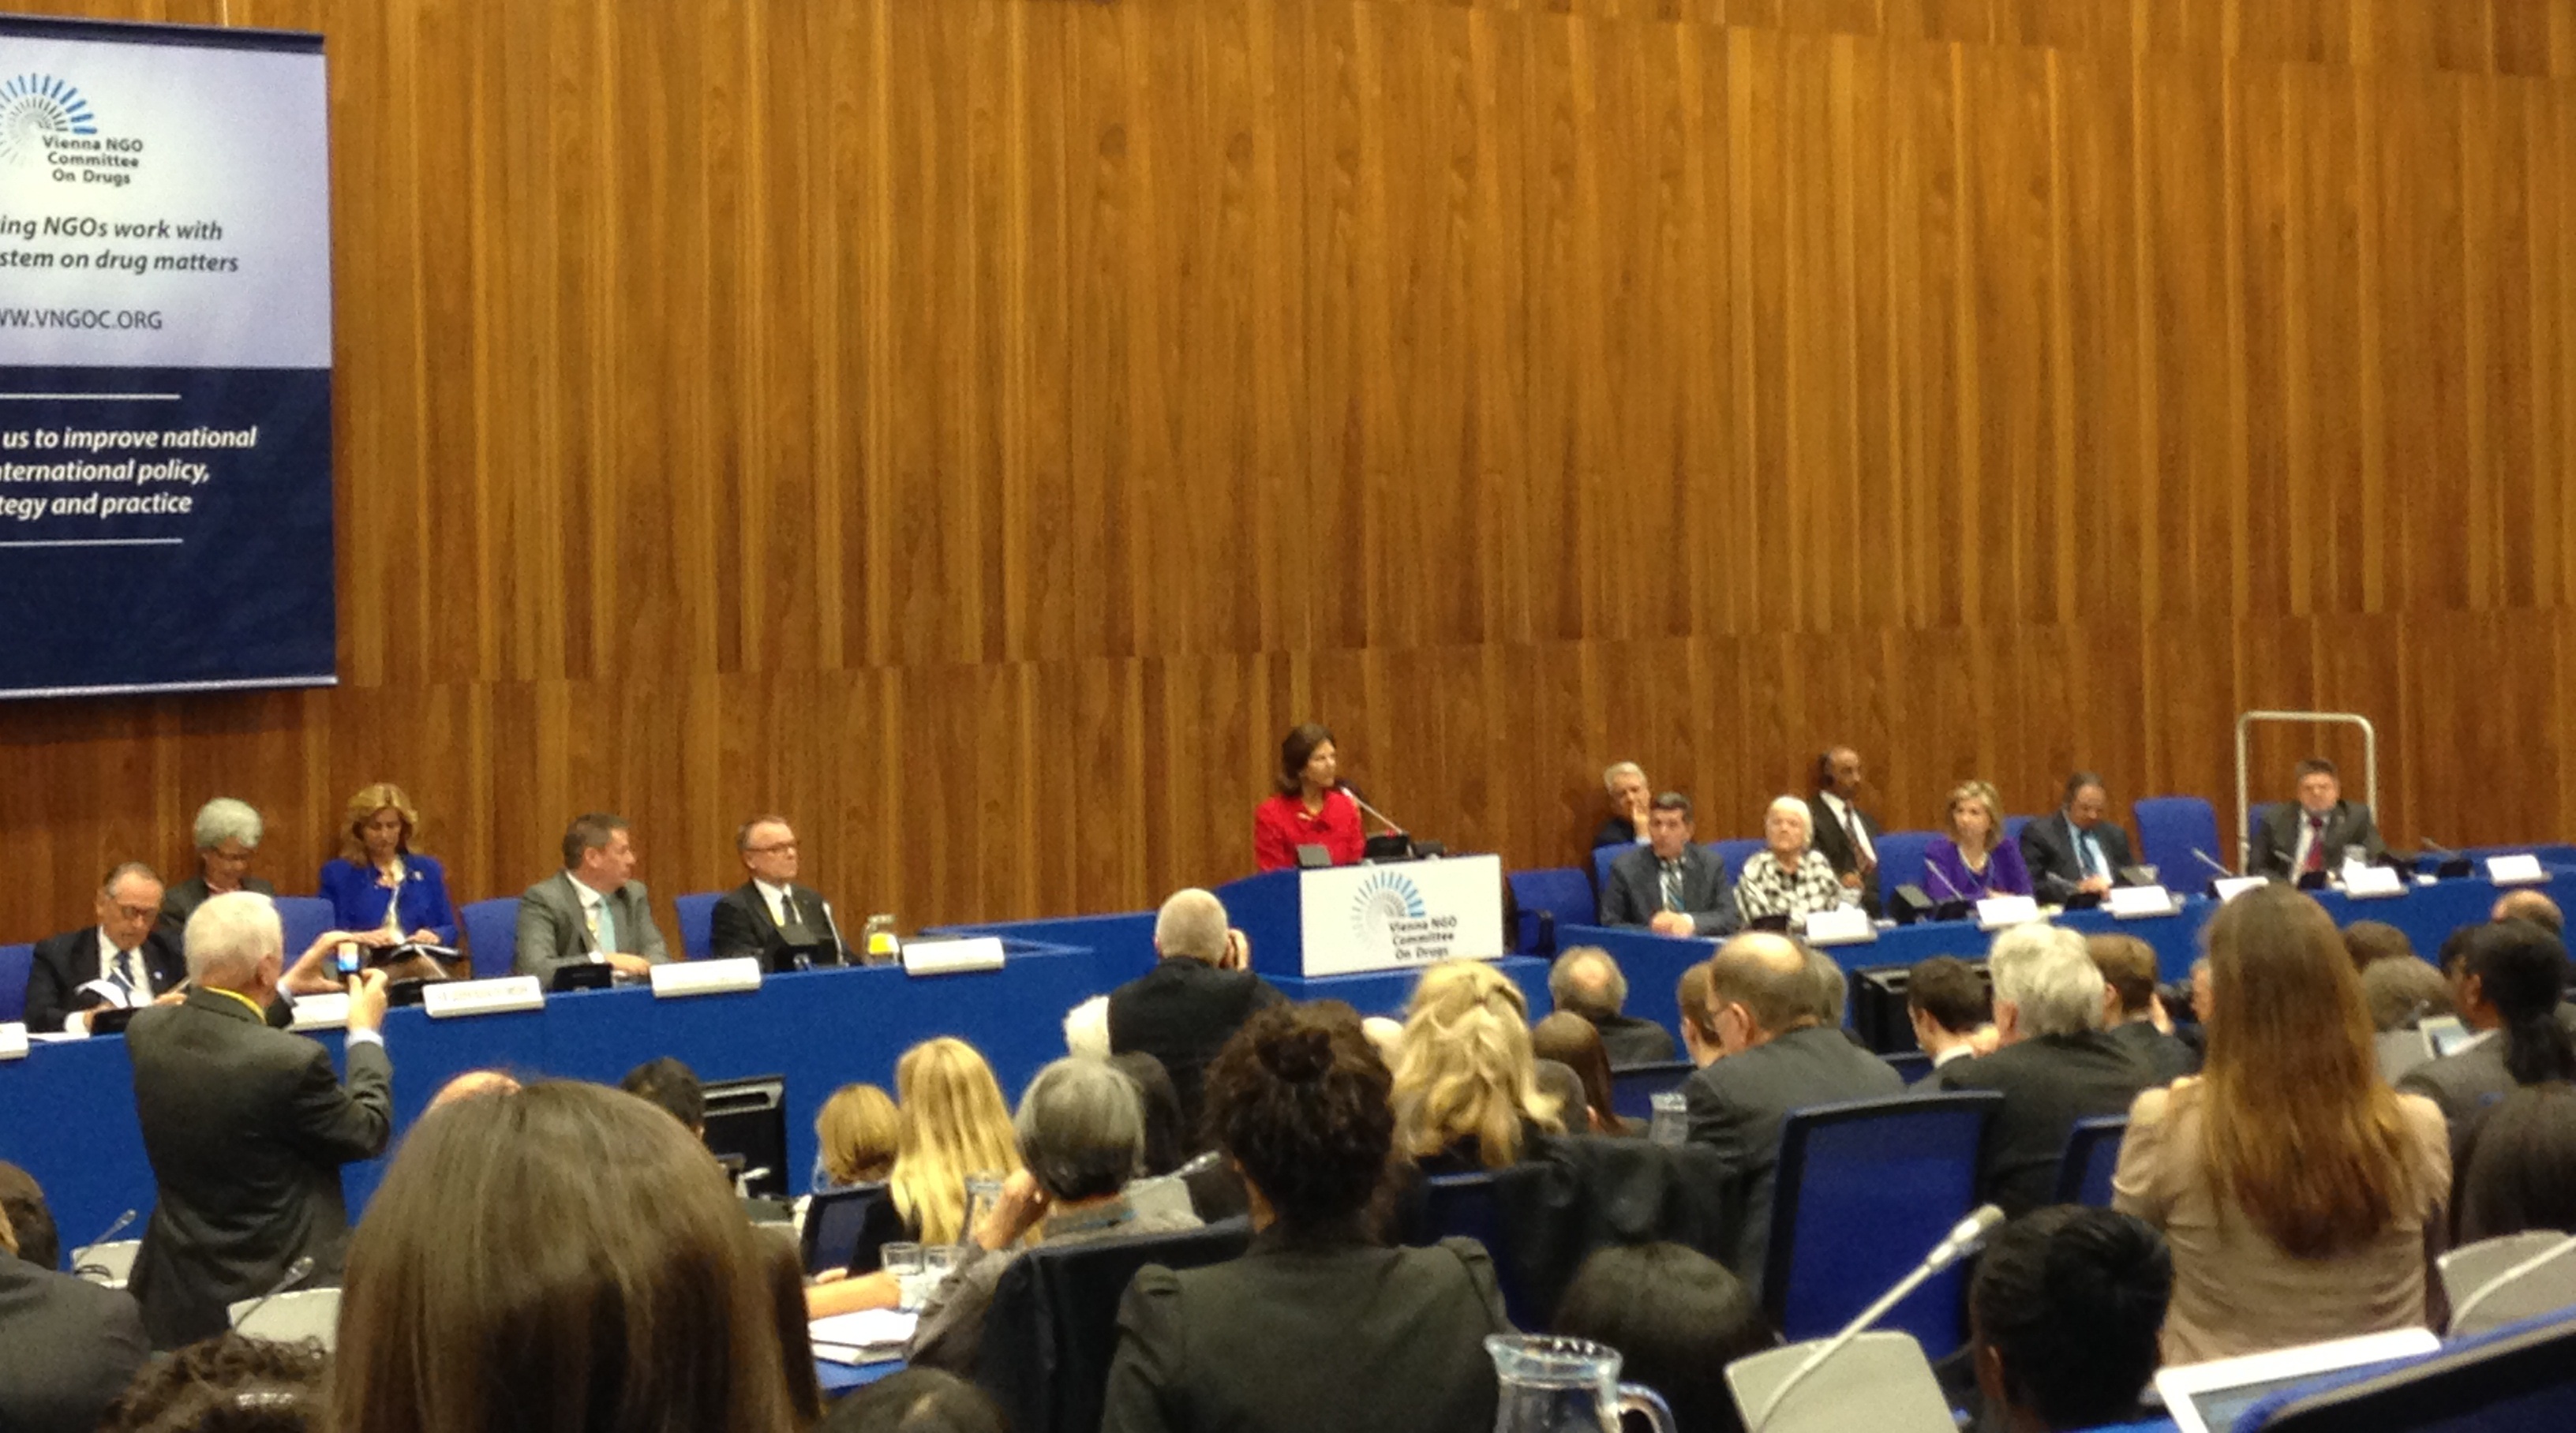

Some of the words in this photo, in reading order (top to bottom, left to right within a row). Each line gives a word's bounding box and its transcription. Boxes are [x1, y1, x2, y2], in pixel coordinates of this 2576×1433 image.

[43, 135, 101, 151] Vienna
[106, 137, 144, 152] NGO
[47, 151, 139, 167] Committee
[52, 167, 76, 182] On
[83, 169, 130, 187] Drugs
[43, 216, 107, 238] NGOs
[114, 220, 170, 238] work
[177, 220, 223, 241] with
[0, 249, 54, 267] stem
[60, 253, 89, 268] on
[95, 249, 148, 275] drug
[154, 255, 239, 272] matters
[2, 431, 29, 449] us
[35, 428, 58, 448] to
[63, 426, 158, 453] improve
[162, 425, 257, 447] national
[0, 458, 135, 481] ternational
[137, 458, 210, 485] policy,
[51, 492, 99, 514] and
[101, 492, 193, 519] practice
[1389, 921, 1428, 932] Vienna
[1431, 915, 1458, 928] NGO
[1392, 931, 1455, 946] Committee
[1395, 948, 1411, 960] On
[1416, 947, 1449, 960] Drugs
